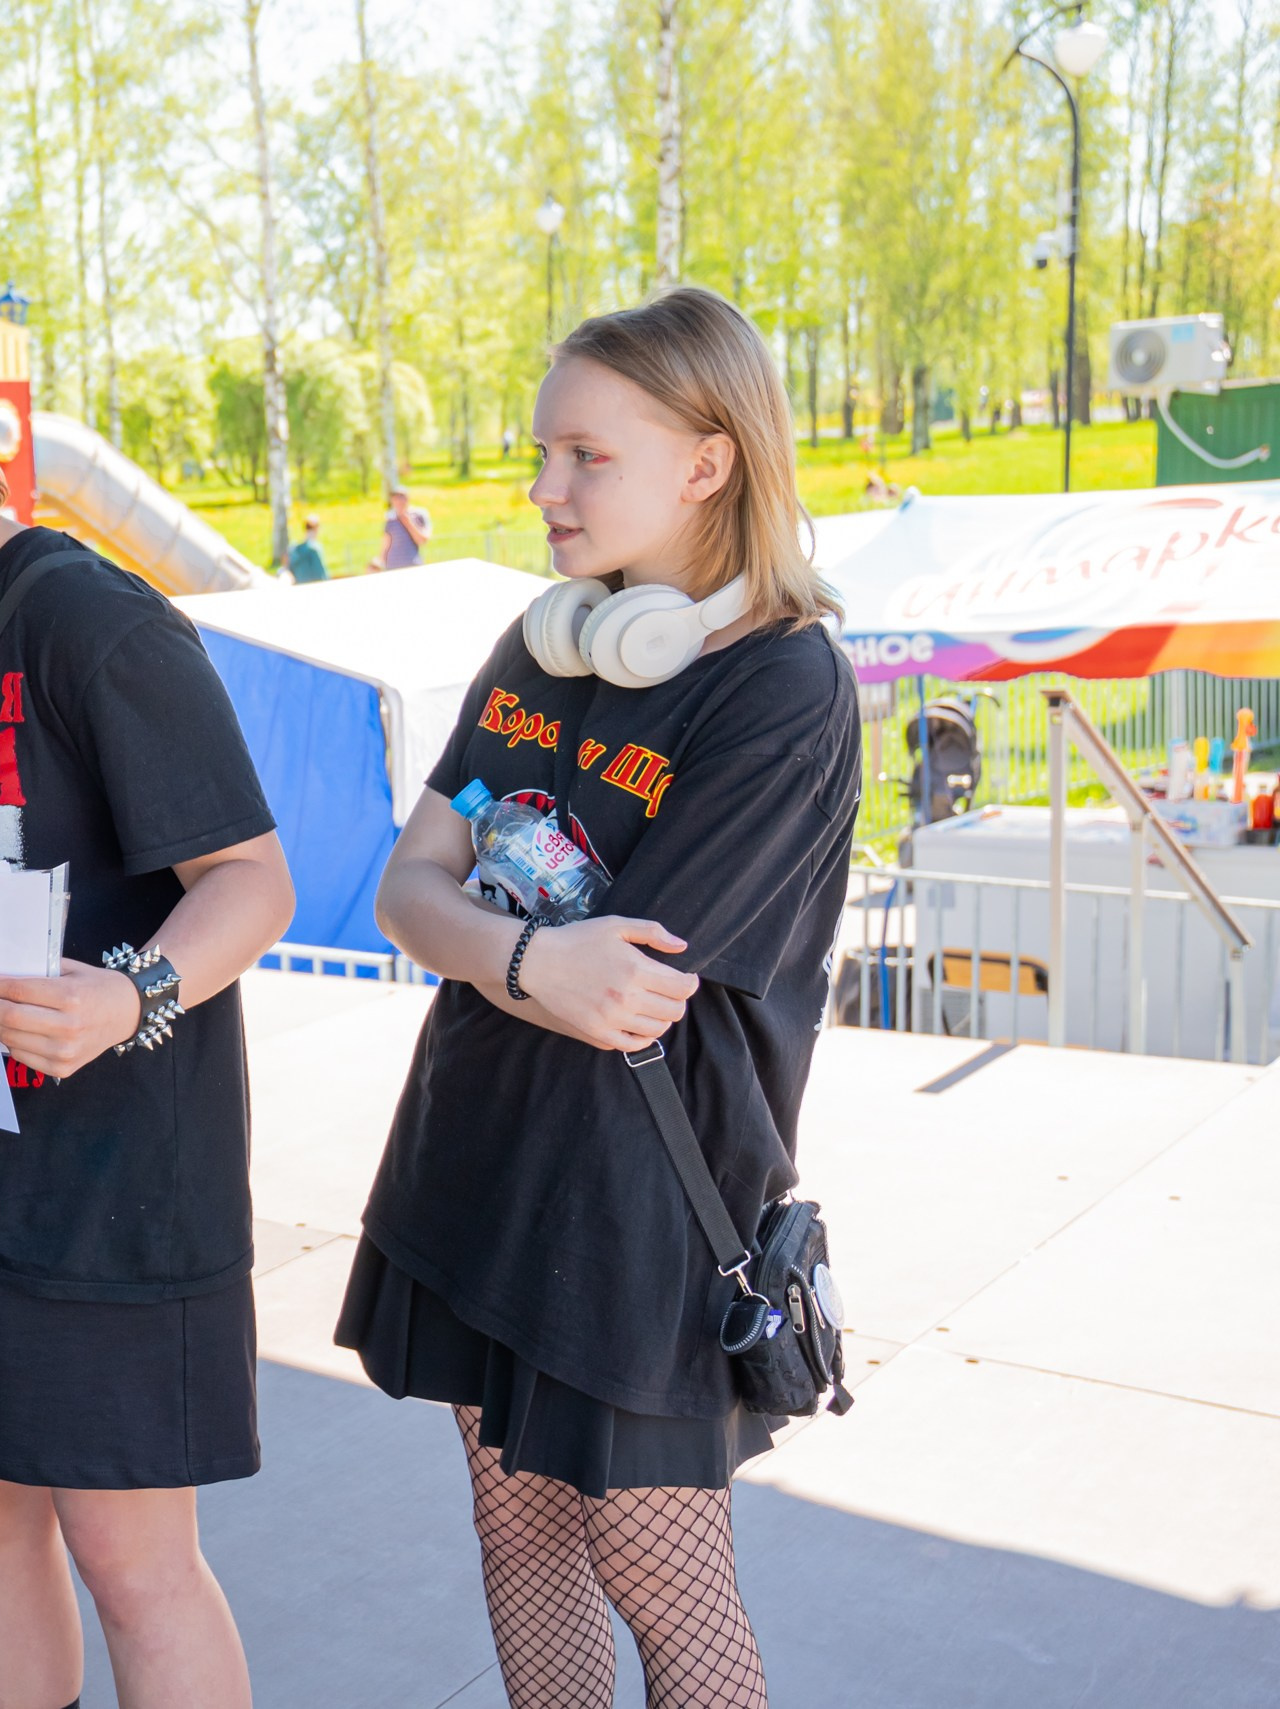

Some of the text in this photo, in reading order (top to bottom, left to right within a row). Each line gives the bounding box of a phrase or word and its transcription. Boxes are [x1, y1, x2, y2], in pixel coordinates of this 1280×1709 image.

[840, 632, 935, 668] ное
[478, 687, 562, 753] Коро
[600, 743, 674, 818] Шу
